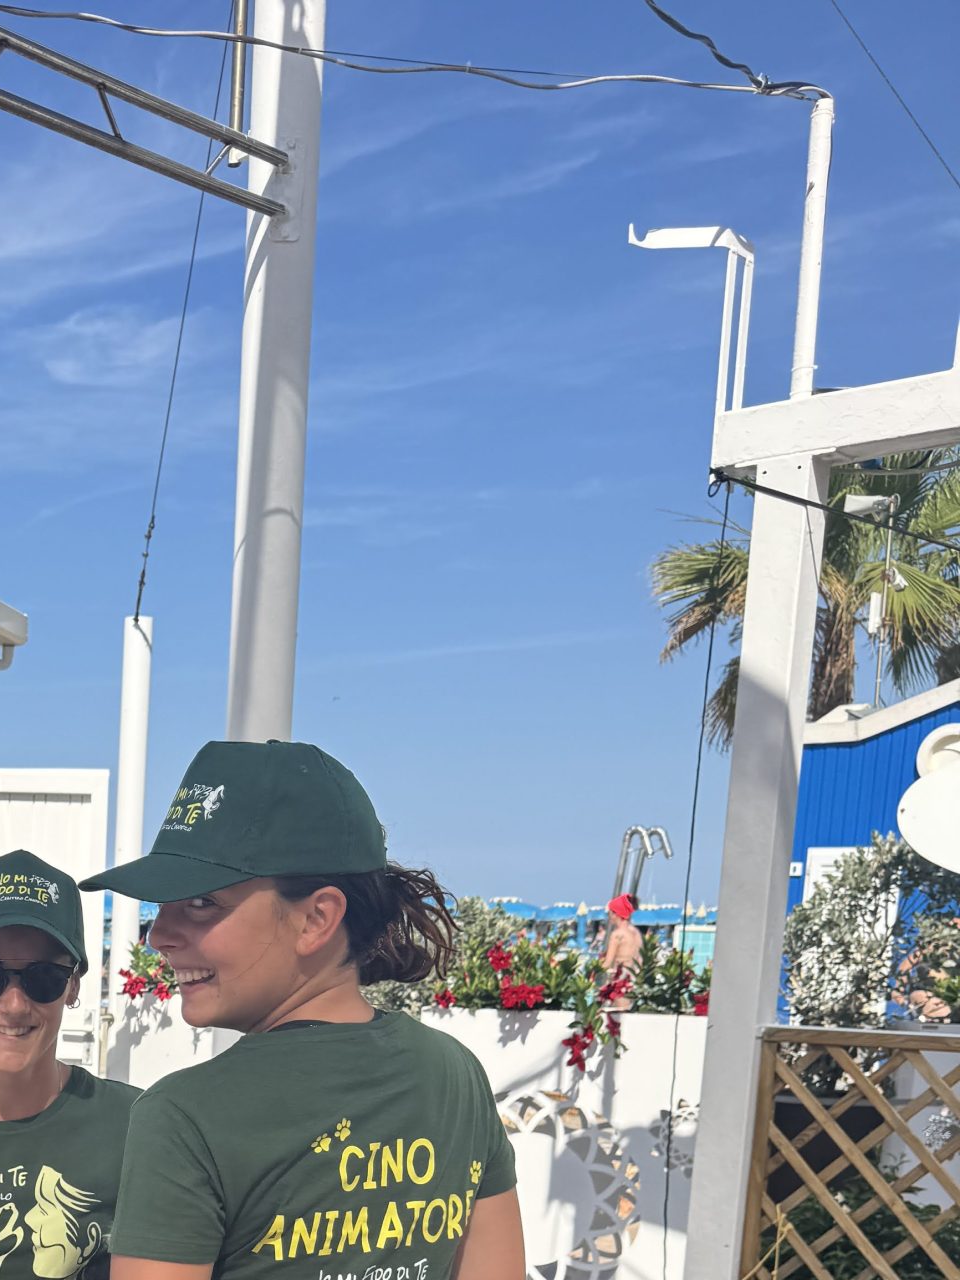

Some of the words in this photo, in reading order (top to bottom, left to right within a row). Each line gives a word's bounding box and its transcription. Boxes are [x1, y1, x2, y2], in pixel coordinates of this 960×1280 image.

[184, 802, 202, 824] TE
[0, 873, 11, 886] IO
[13, 874, 27, 883] MI
[18, 885, 31, 894] DI
[34, 887, 50, 903] TE
[339, 1137, 435, 1192] CINO
[7, 1165, 29, 1187] TE
[397, 1266, 409, 1280] DI
